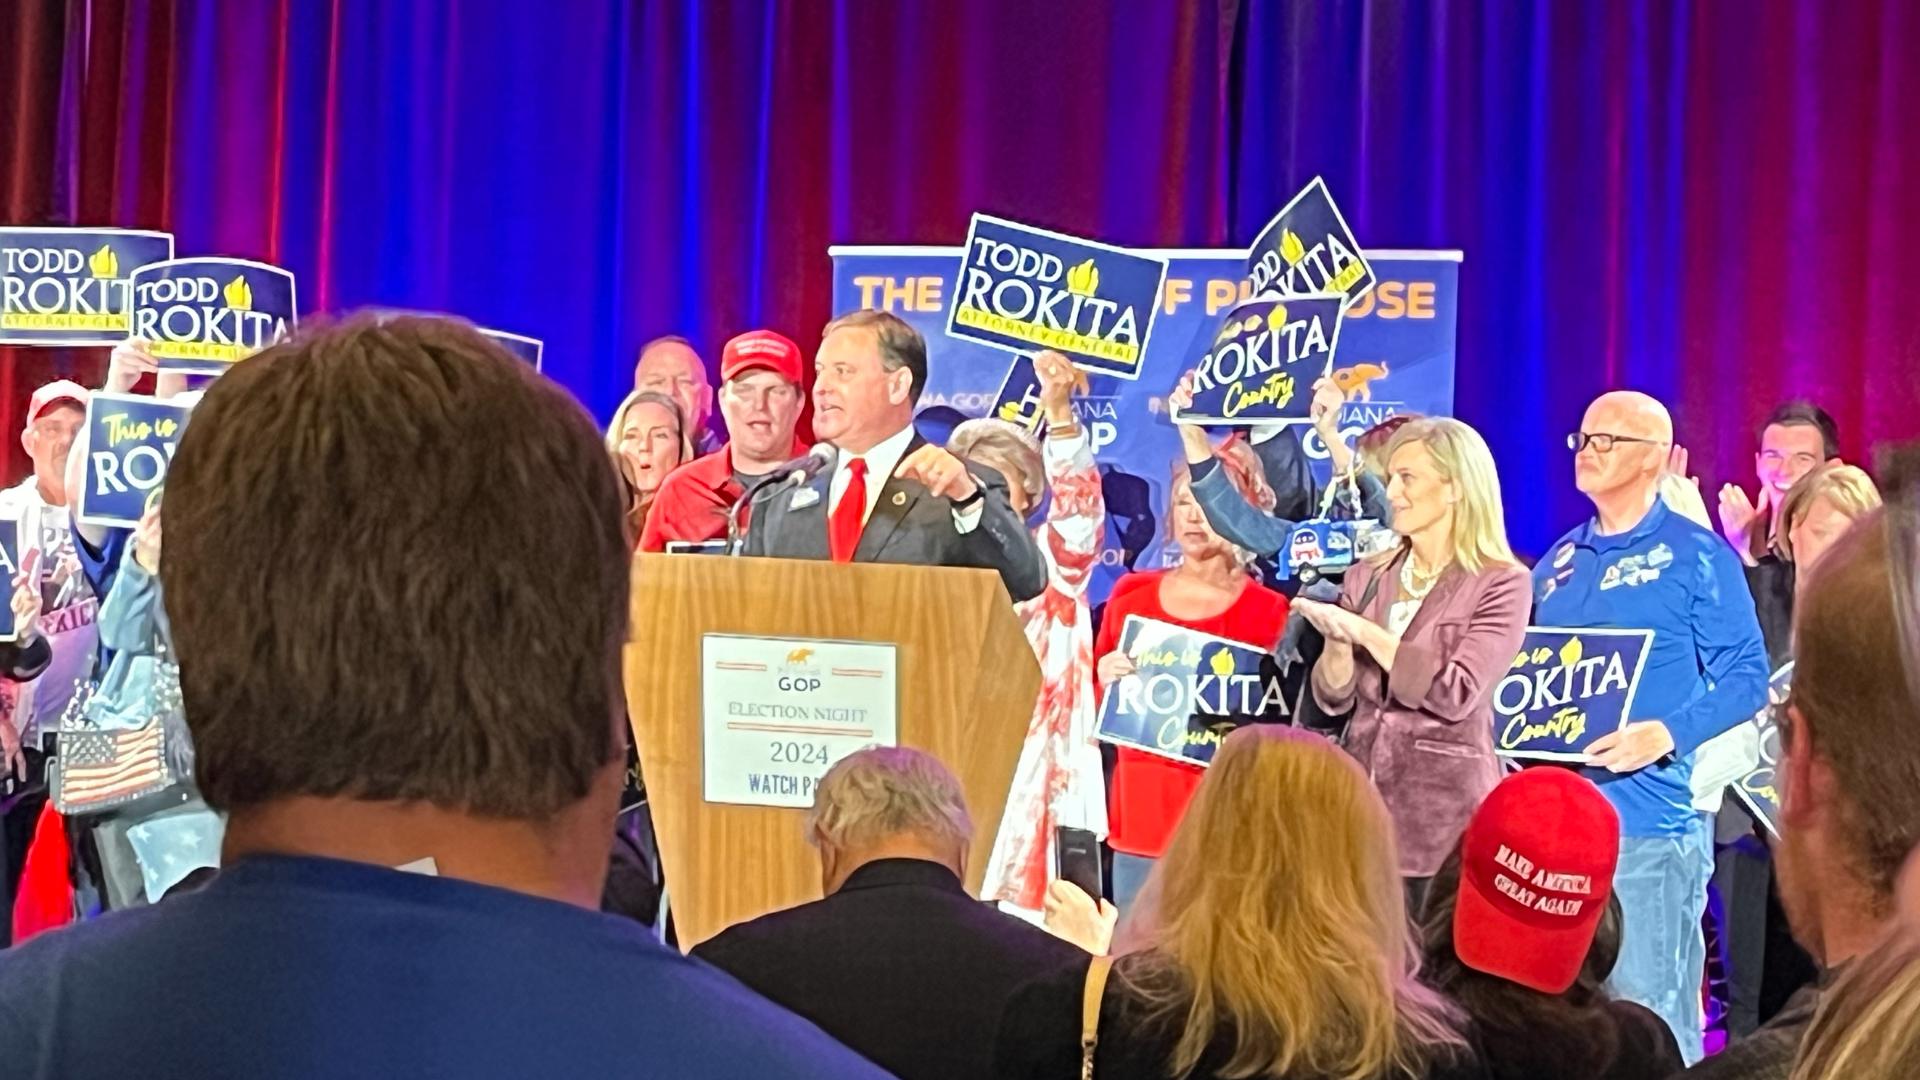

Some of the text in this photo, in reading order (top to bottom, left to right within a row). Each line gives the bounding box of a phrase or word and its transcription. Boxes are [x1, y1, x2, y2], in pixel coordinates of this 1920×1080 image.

[5, 247, 84, 274] TODD
[974, 236, 1063, 284] TODD
[1257, 232, 1360, 297] KITA
[3, 276, 132, 315] ROKIT
[136, 277, 219, 305] TODD
[853, 276, 944, 312] THE
[1163, 279, 1194, 316] F
[962, 267, 1140, 348] ROKITA
[960, 307, 1132, 361] ATTORNEY GENERAL
[1192, 314, 1329, 394] ROKITA
[1222, 371, 1295, 418] Country
[101, 412, 152, 448] This
[777, 676, 822, 693] GOP
[1115, 672, 1291, 716] ROKITA
[1492, 651, 1628, 717] OKITA
[728, 701, 868, 723] ELECTION NIGHT
[1500, 707, 1587, 750] Country
[770, 741, 829, 765] 2024
[748, 773, 799, 796] WATCH
